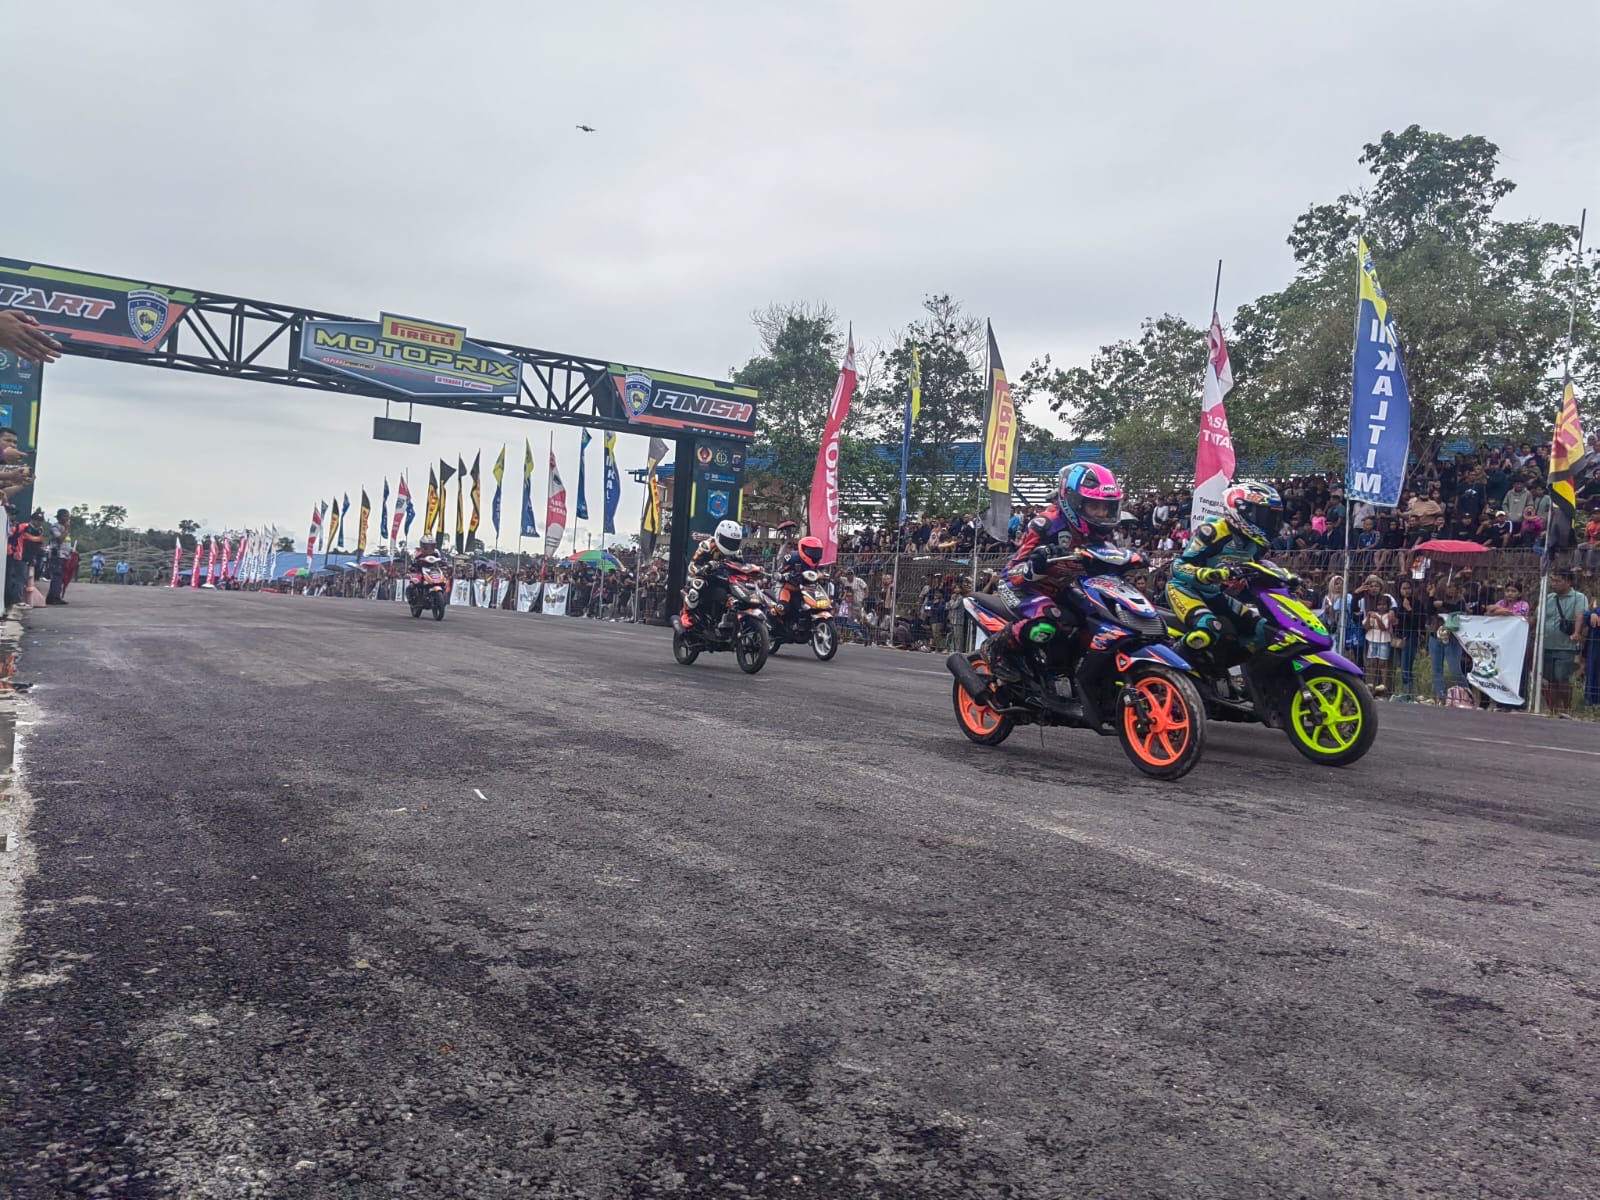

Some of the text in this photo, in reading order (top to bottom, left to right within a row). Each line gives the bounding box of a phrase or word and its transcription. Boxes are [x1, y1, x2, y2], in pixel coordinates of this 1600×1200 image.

[391, 321, 456, 347] PIRELLI
[314, 327, 518, 379] MOTOPRIX
[653, 389, 753, 422] FINISH
